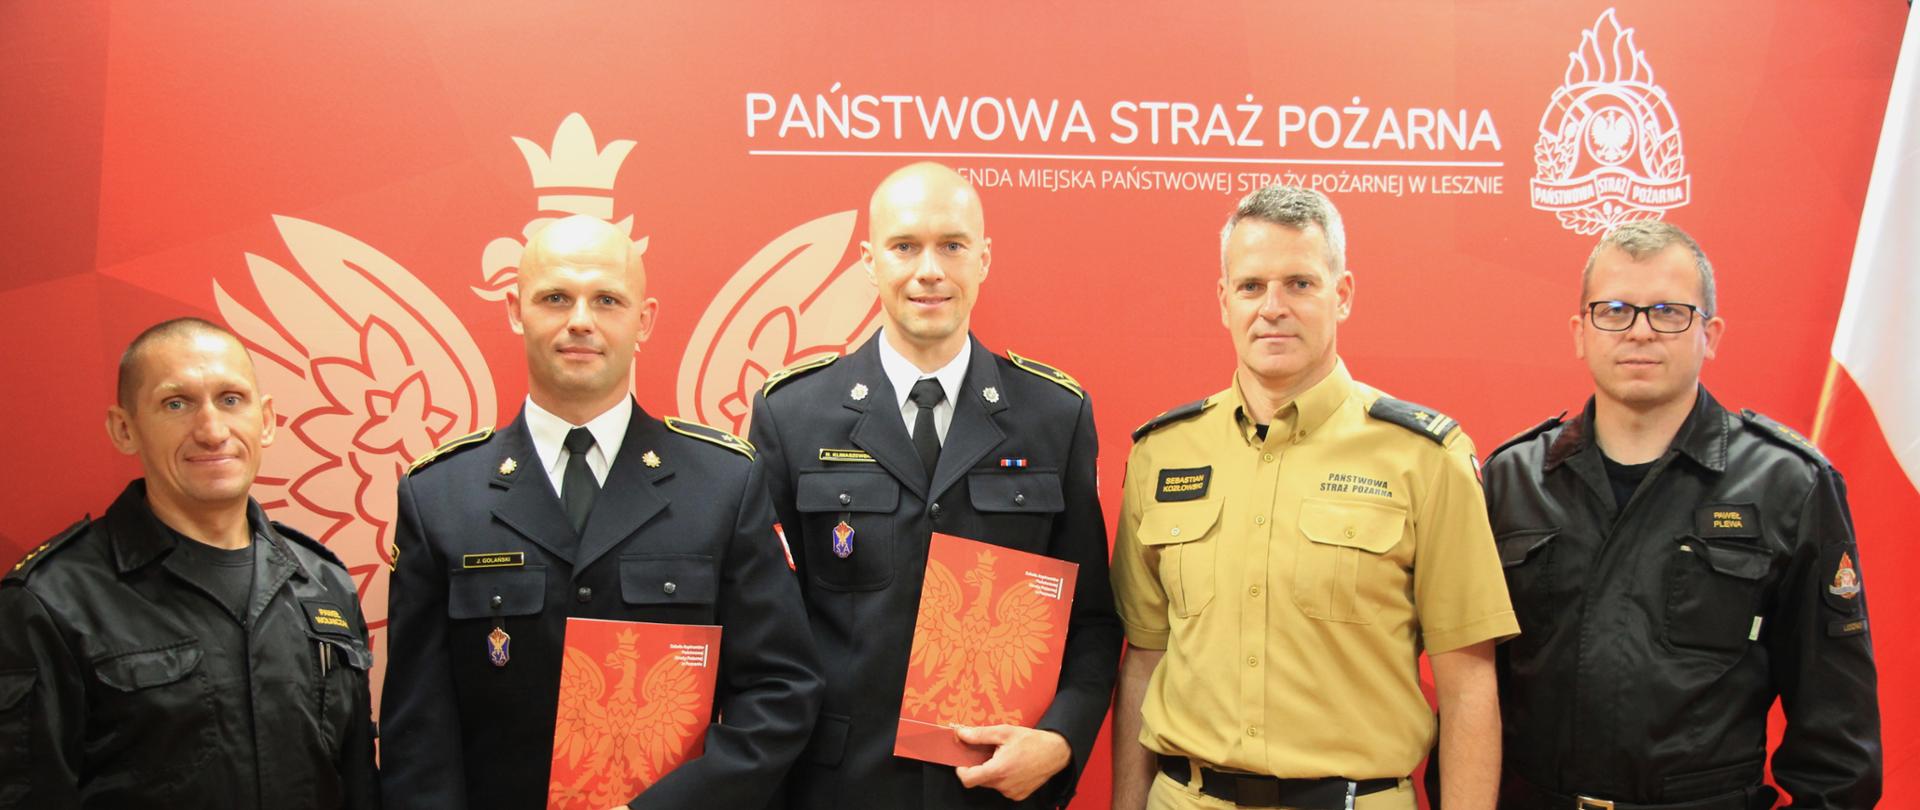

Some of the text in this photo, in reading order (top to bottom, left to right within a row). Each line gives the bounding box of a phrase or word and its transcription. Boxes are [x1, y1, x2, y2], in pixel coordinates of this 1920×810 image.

[746, 81, 1502, 151] PAŃSTWOWA STRAŻ POŻARNA
[957, 167, 1013, 188] ENDA
[1018, 168, 1096, 193] MIEJSKA
[1102, 166, 1232, 194] PAŃSTWOWEJ
[1311, 169, 1404, 197] POŻARNEJ
[1408, 175, 1428, 193] W
[1431, 175, 1503, 195] LESZNIE
[1165, 474, 1205, 485] SEBASTIAN
[1713, 520, 1744, 528] PLEWA
